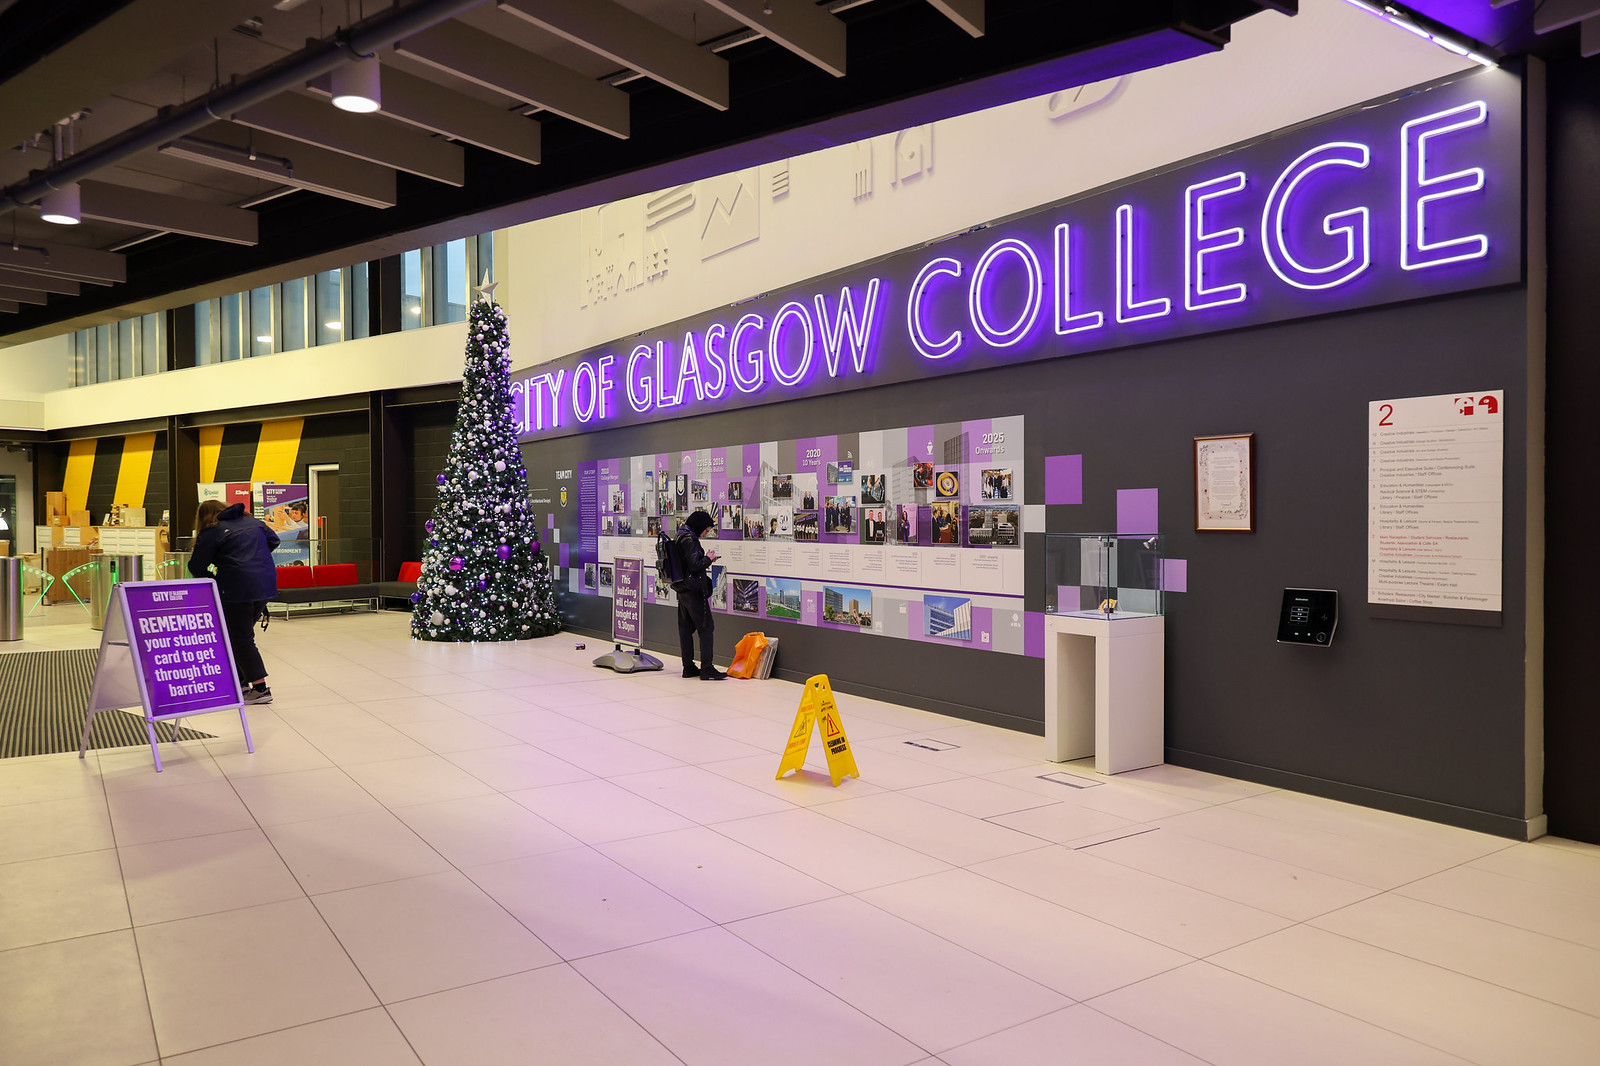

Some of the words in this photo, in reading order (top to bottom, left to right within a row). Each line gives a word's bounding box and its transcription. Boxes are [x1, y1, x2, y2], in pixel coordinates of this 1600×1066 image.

[507, 369, 565, 435] CITY
[572, 355, 614, 422] OF
[626, 278, 880, 413] GLASGOW
[906, 100, 1488, 359] COLLEGE
[1378, 404, 1393, 426] 2
[982, 432, 1004, 443] 2025
[806, 449, 821, 458] 2020
[975, 445, 1005, 454] Onwards
[556, 470, 564, 480] TEAM
[621, 575, 631, 584] This
[617, 586, 636, 598] building
[624, 599, 637, 609] close
[616, 609, 631, 620] tonight
[632, 612, 638, 620] at
[138, 612, 214, 634] REMEMBER
[617, 620, 635, 632] 9.30pm
[144, 637, 171, 652] your
[173, 631, 217, 647] student
[154, 650, 181, 665] card
[182, 650, 194, 662] to
[196, 648, 216, 663] get
[155, 664, 201, 682] through
[202, 663, 221, 676] the
[169, 681, 215, 697] barriers
[827, 737, 841, 748] CLEANING
[831, 744, 847, 755] PROGRESS
